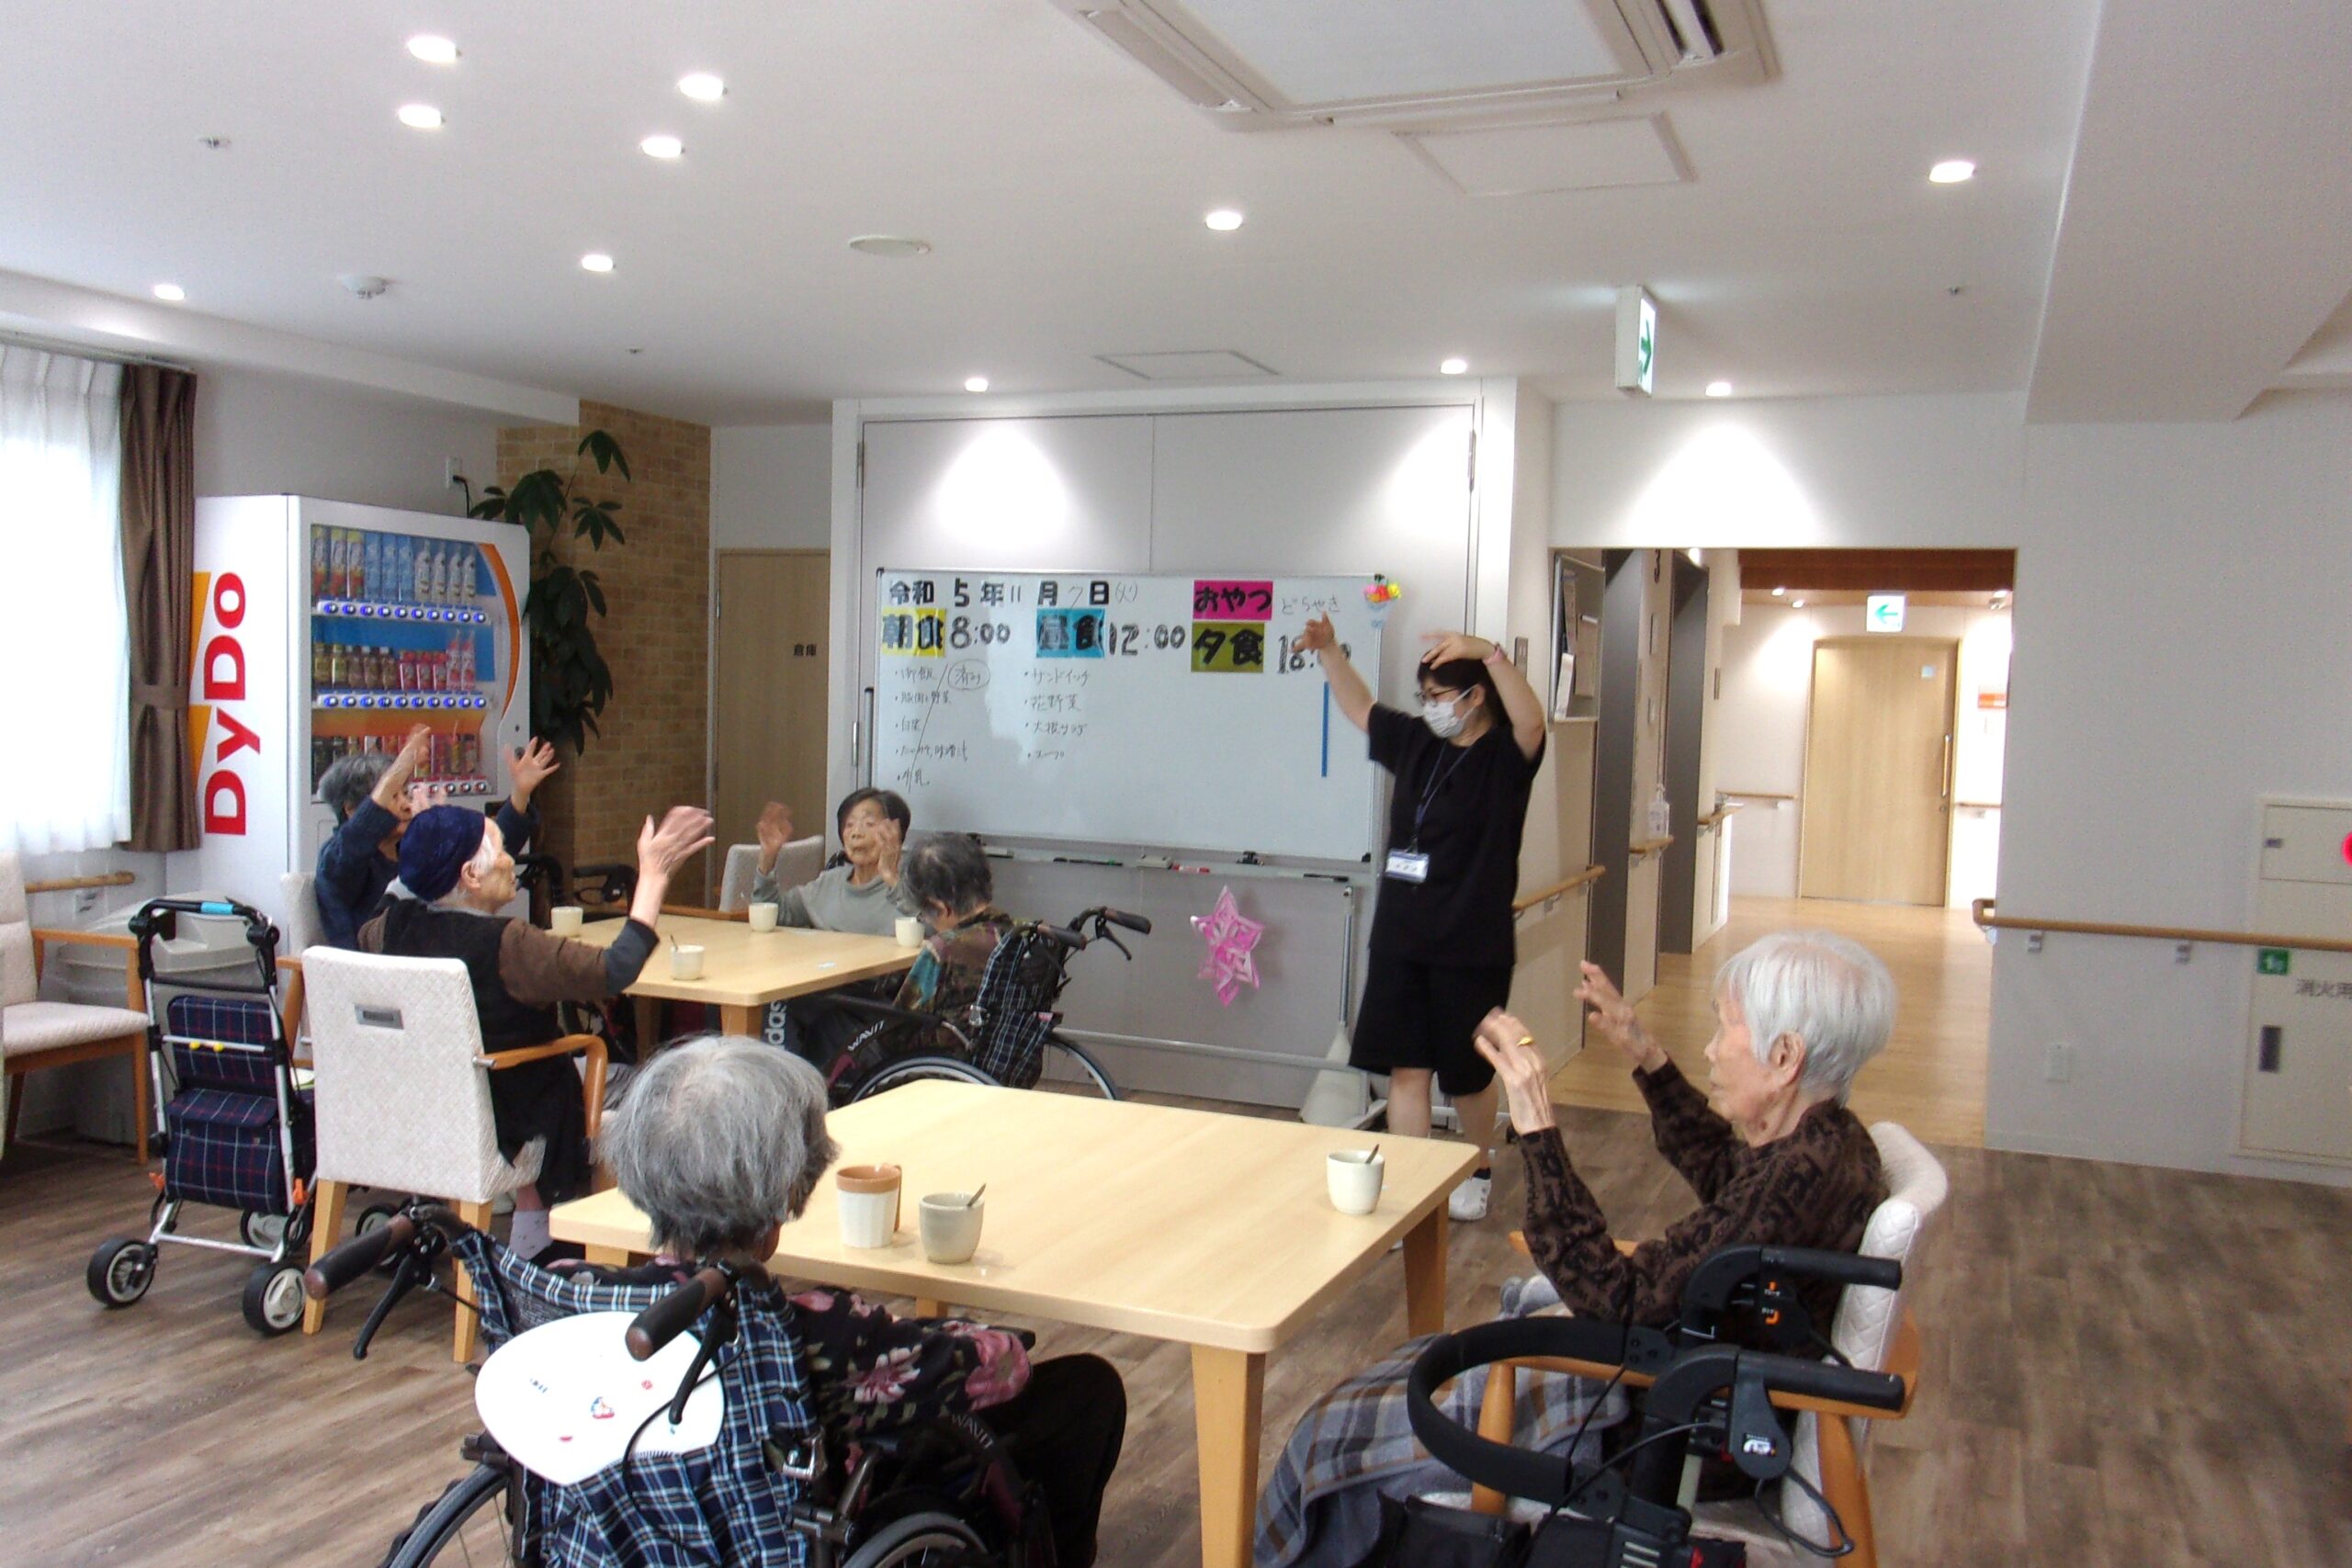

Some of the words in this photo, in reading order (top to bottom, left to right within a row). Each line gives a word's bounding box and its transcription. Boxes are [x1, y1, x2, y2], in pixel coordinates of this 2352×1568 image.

[1194, 586, 1272, 614] おやつ
[950, 615, 1011, 649] 8:00
[1109, 622, 1186, 656] 12:00
[1193, 628, 1263, 666] 夕食
[203, 571, 261, 836] DyDo
[764, 999, 787, 1050] das
